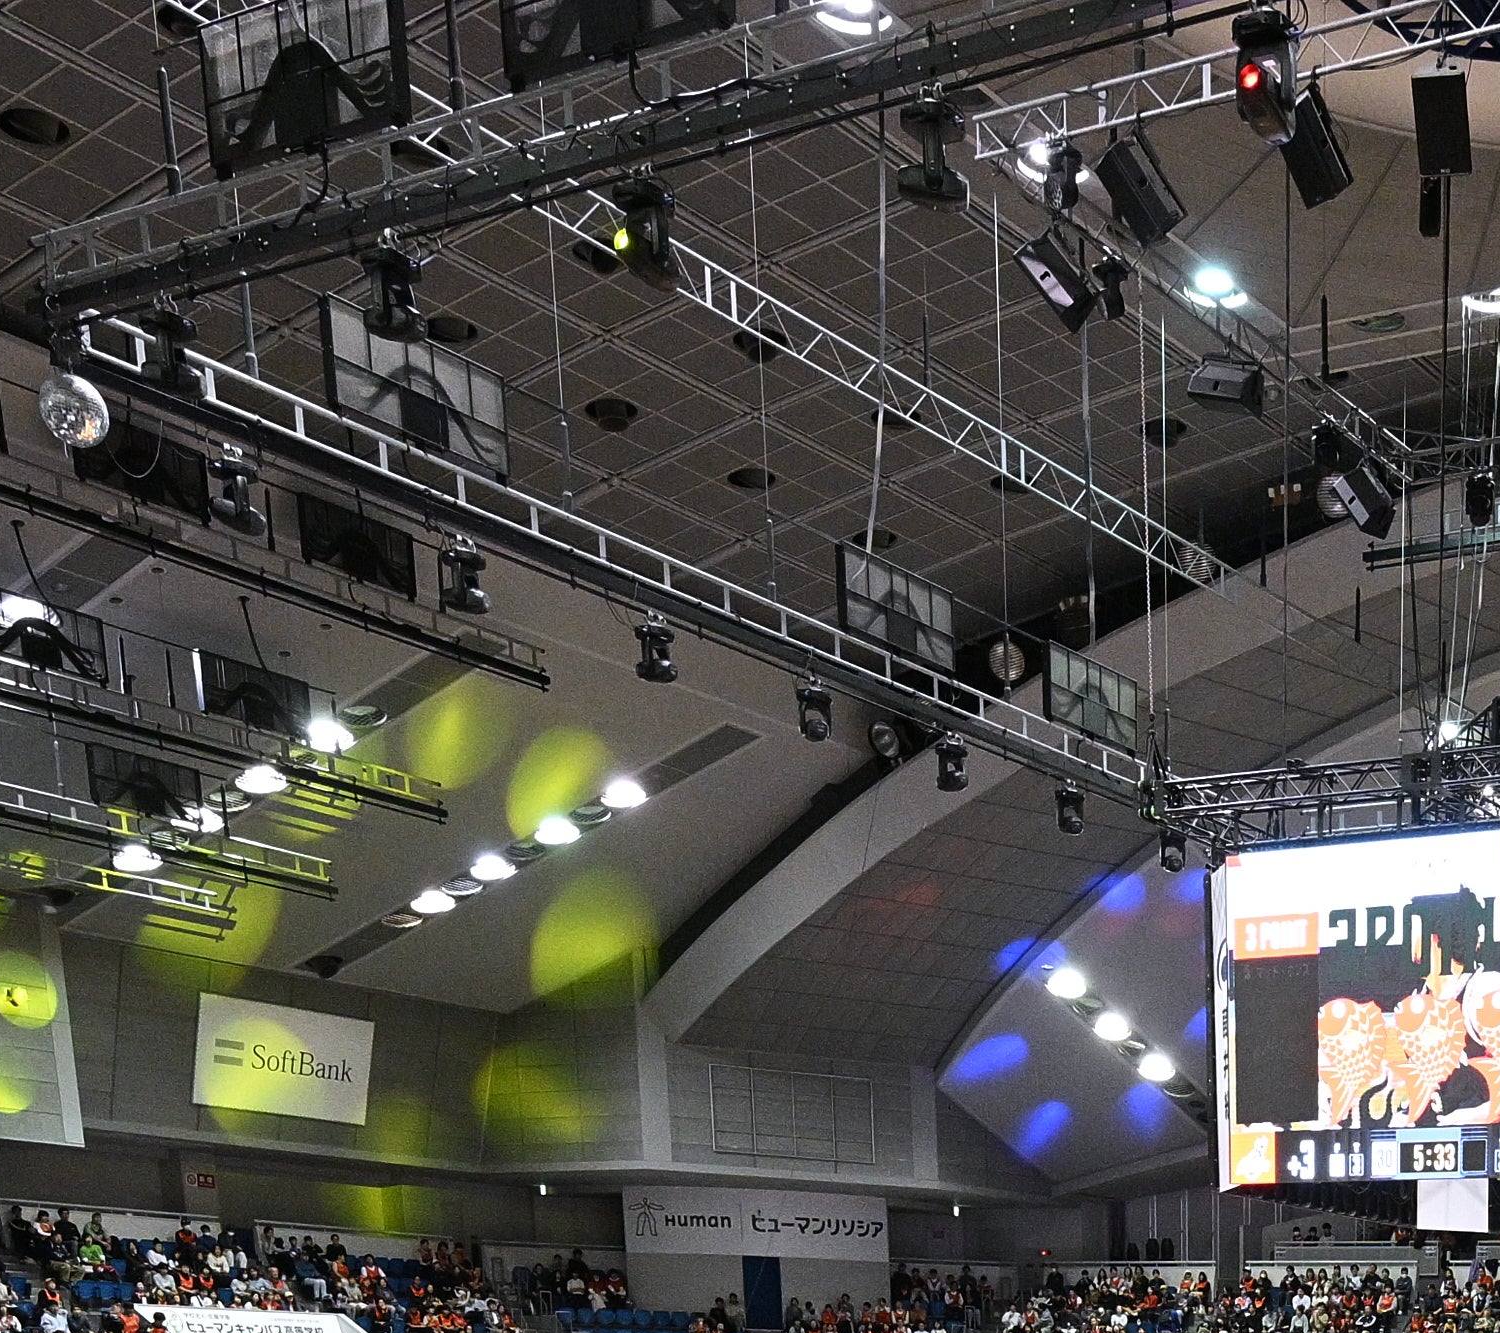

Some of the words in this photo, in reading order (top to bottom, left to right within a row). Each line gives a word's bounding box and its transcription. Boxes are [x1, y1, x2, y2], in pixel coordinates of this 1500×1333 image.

[1262, 919, 1309, 951] POINT
[252, 1045, 353, 1084] SoftBank
[1413, 1143, 1456, 1172] 5:33
[665, 1210, 732, 1230] Human
[750, 1207, 885, 1241] ヒューマンリソシア
